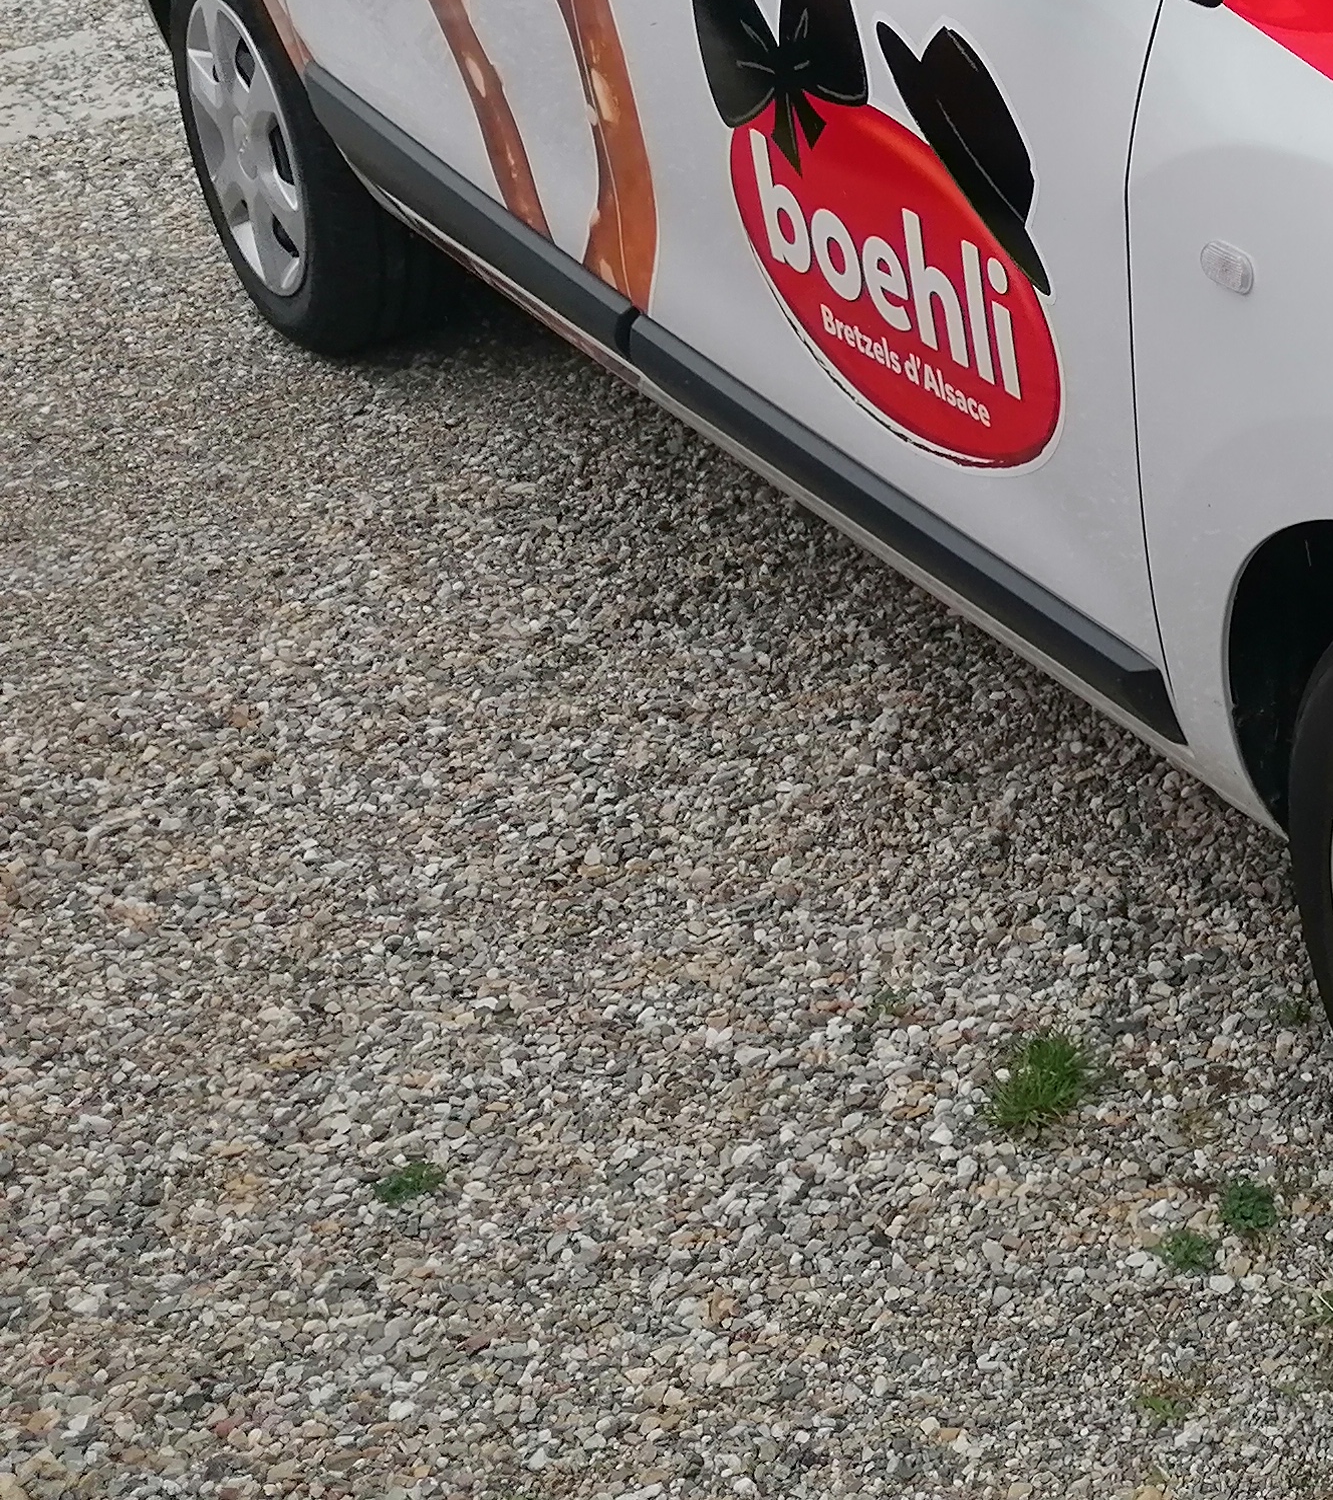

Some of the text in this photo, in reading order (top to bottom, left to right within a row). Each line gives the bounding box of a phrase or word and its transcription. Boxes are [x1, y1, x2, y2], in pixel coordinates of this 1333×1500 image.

[748, 127, 1022, 401] boehli
[819, 303, 992, 428] Bretzels d'Alsace
